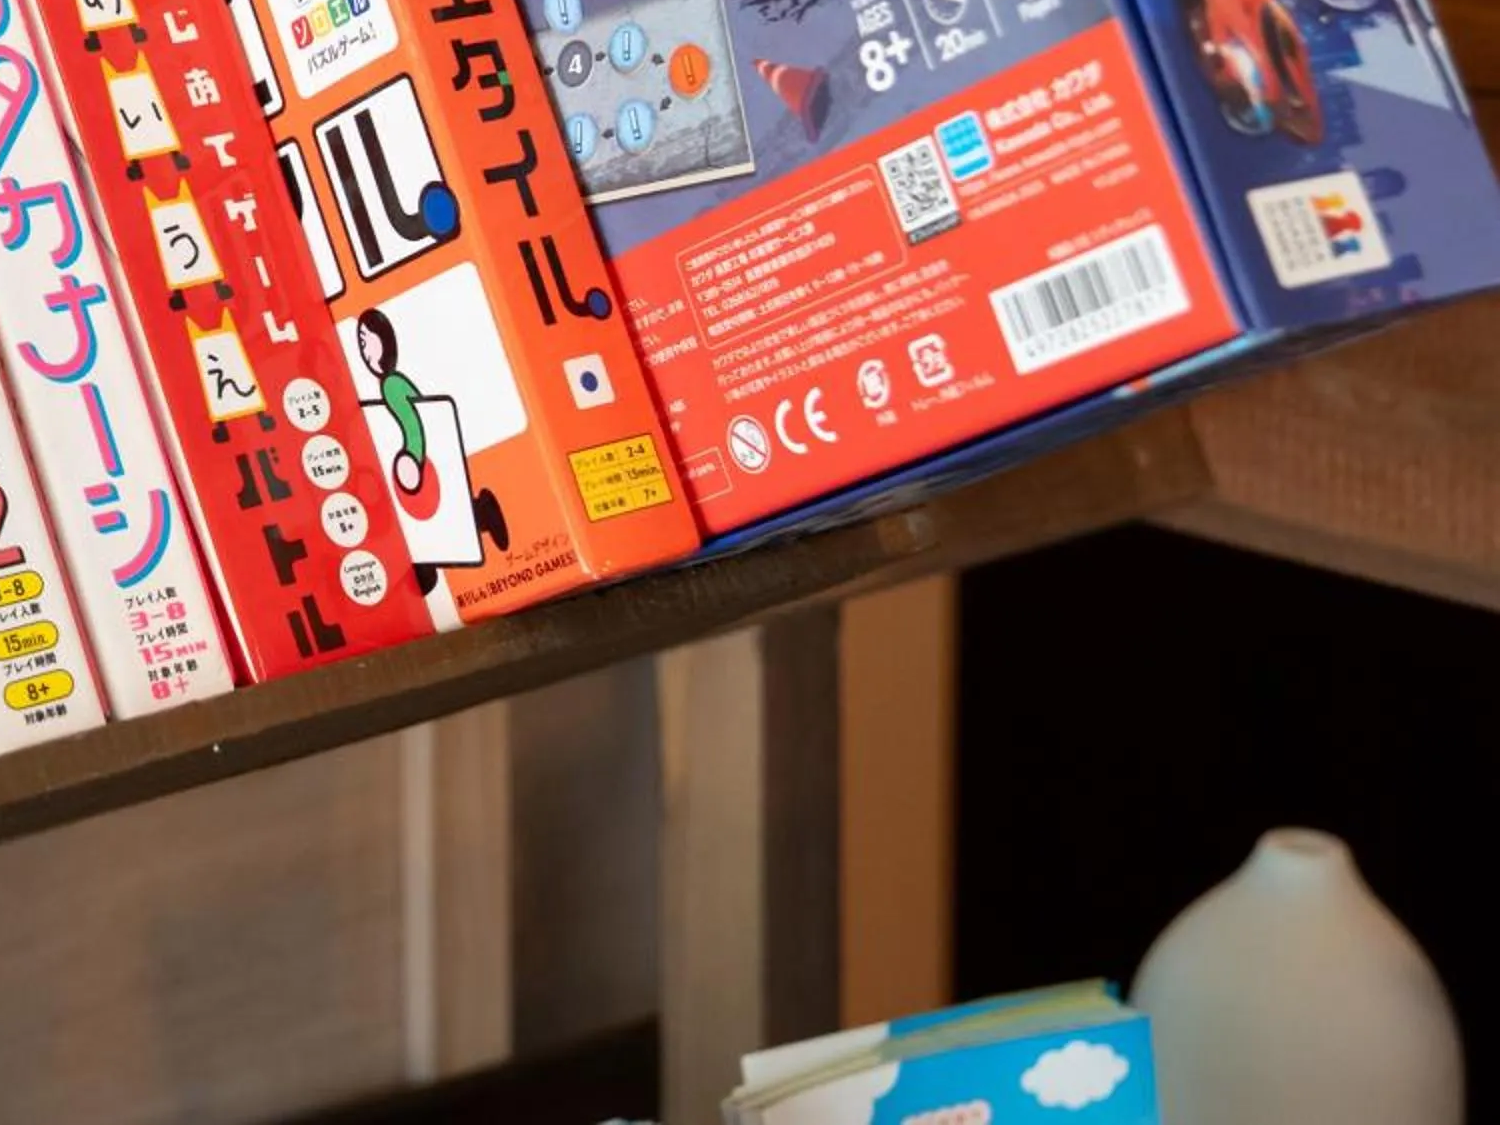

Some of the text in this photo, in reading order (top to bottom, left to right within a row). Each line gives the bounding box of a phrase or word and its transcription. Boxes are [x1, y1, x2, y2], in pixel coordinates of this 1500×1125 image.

[304, 20, 377, 75] パズルゲーム!
[566, 52, 584, 75] 4
[859, 30, 913, 92] 8+
[124, 587, 178, 611] プレイ人数
[3, 633, 49, 654] 15min
[135, 623, 189, 646] プレイ時間
[3, 654, 58, 676] プレイ時間
[147, 660, 199, 682] 対象年齢
[27, 680, 50, 701] 8+
[24, 705, 68, 725] 対象年齢
